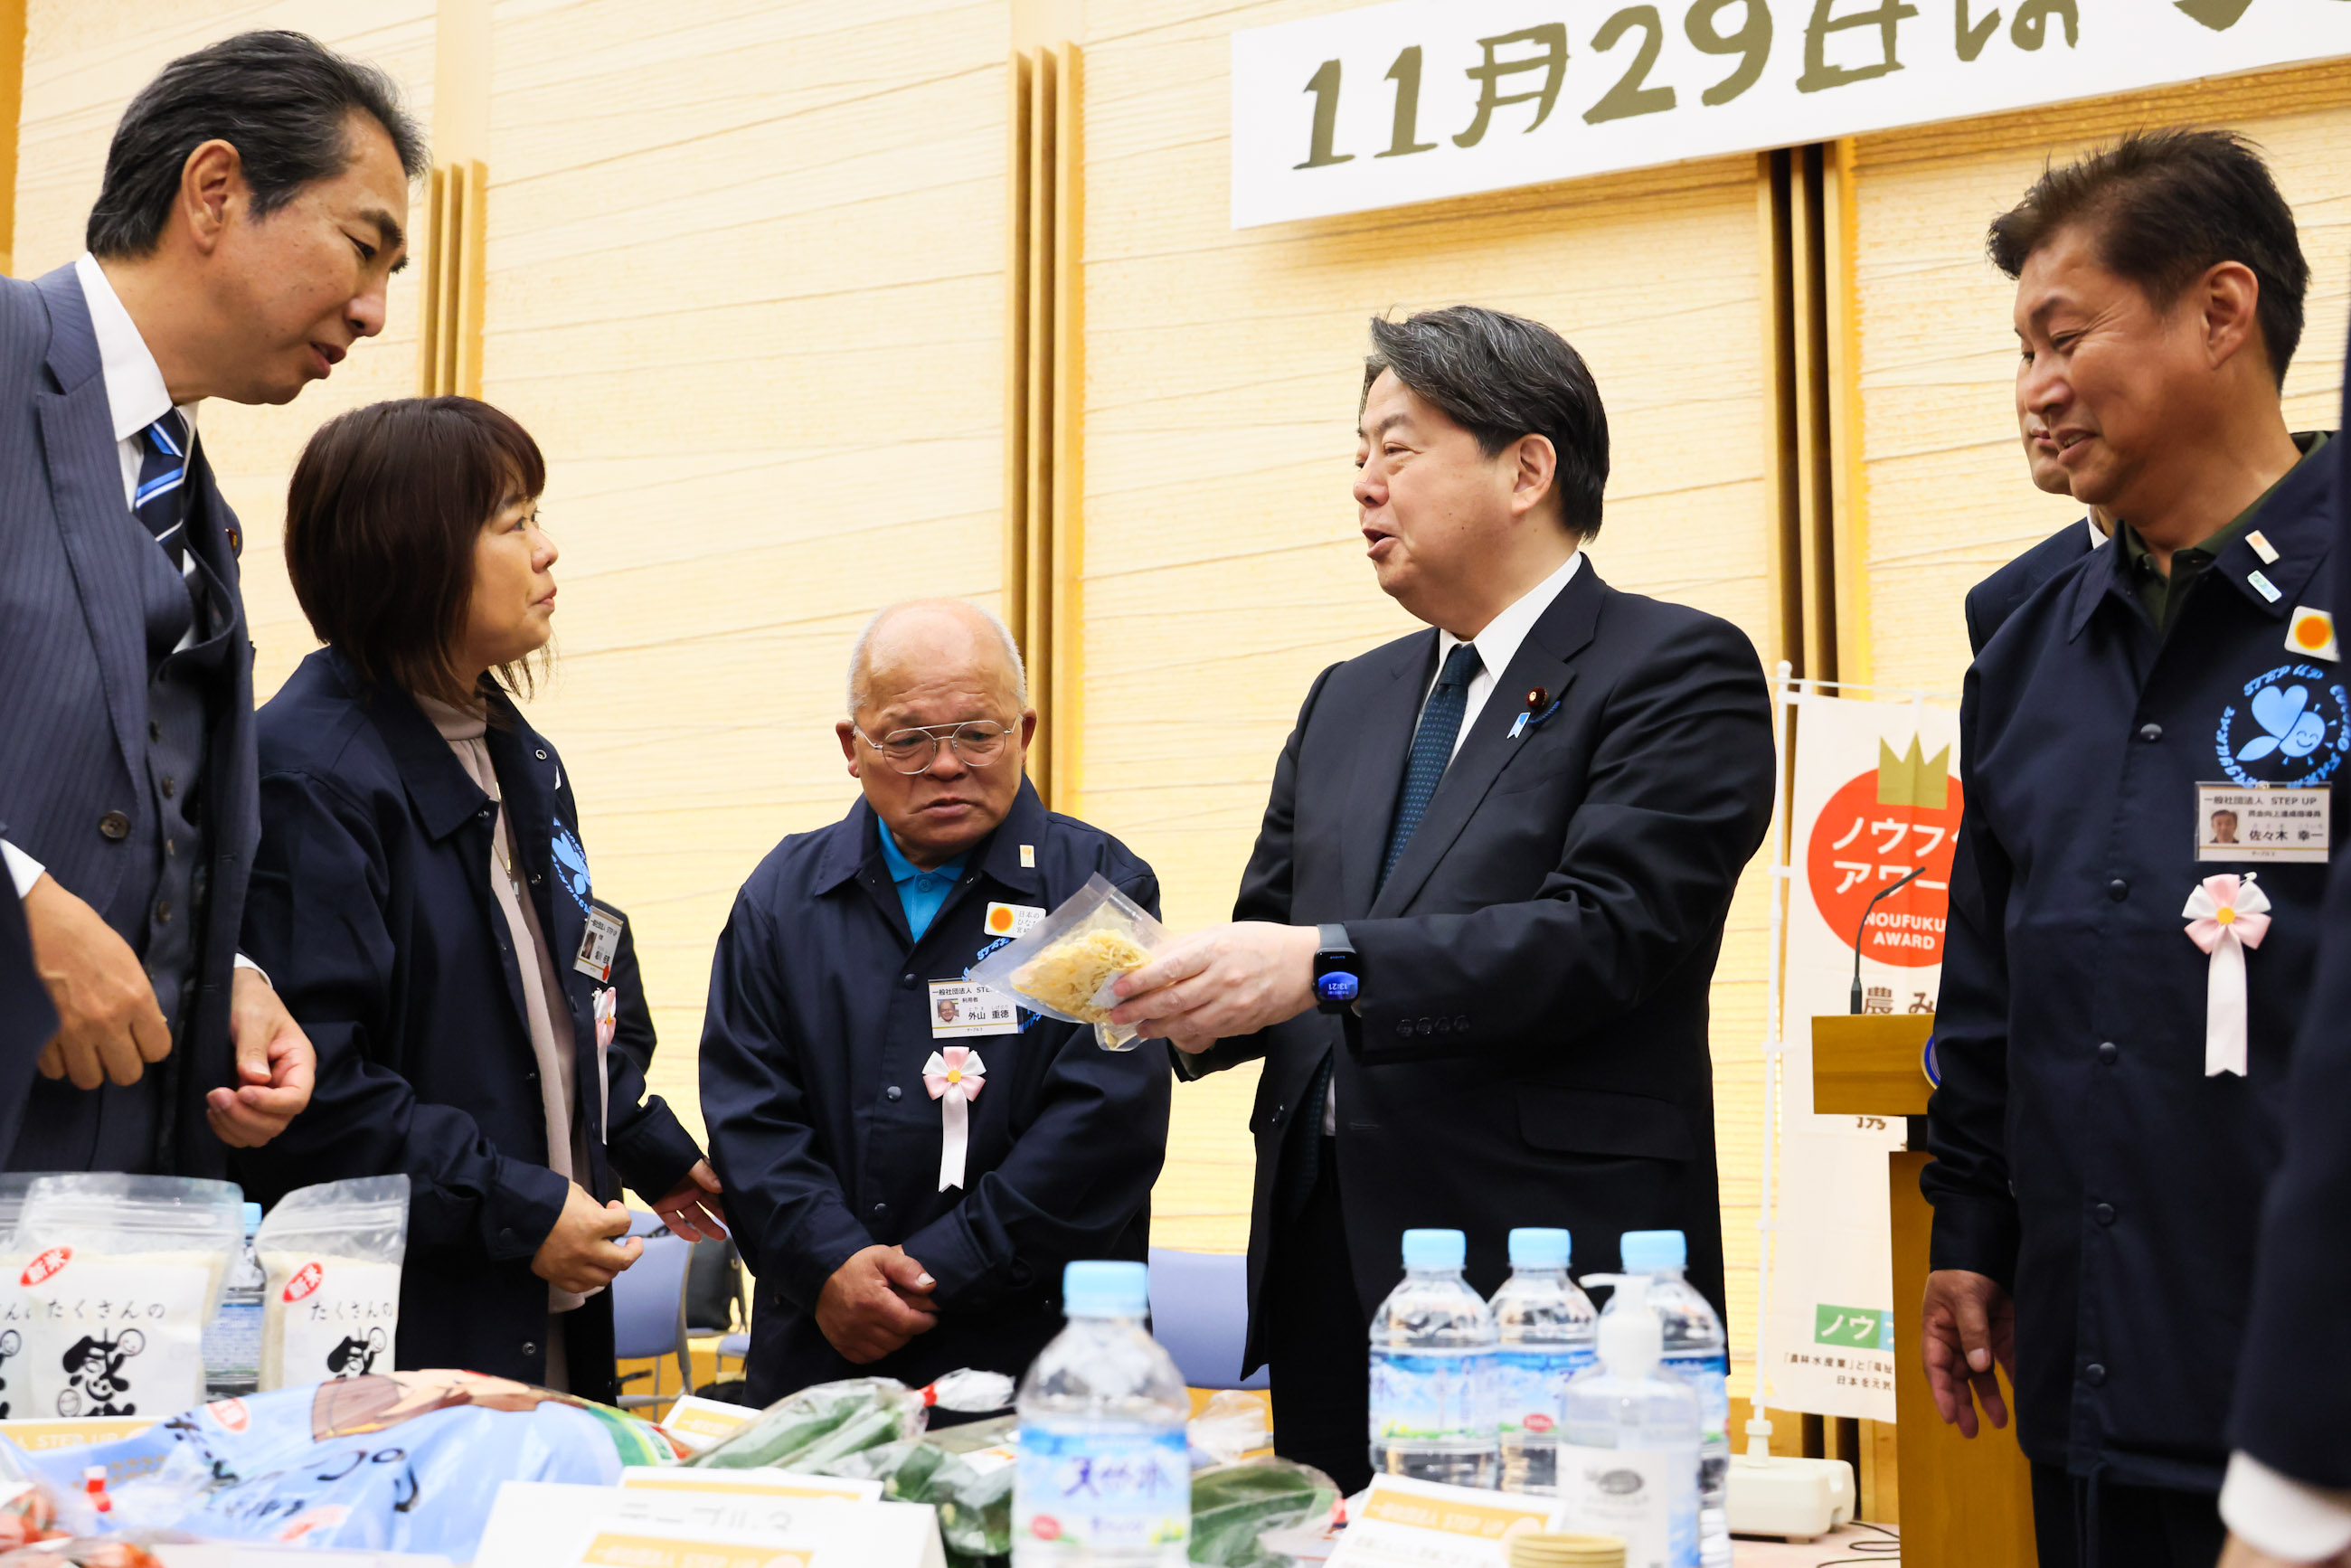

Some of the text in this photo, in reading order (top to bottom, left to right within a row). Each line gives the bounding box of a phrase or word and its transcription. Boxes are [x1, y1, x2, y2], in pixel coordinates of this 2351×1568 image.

[2205, 796, 2317, 806] 一般社団法人 STEP UP
[1832, 817, 1959, 858] ノウフ
[2250, 830, 2288, 841] 佐々木
[1873, 931, 1935, 950] AWARD
[932, 987, 972, 996] 一般社団法人
[968, 1010, 1009, 1021] 外山 重徳
[49, 1299, 165, 1320] たくさんの
[312, 1301, 392, 1321] たくさんの
